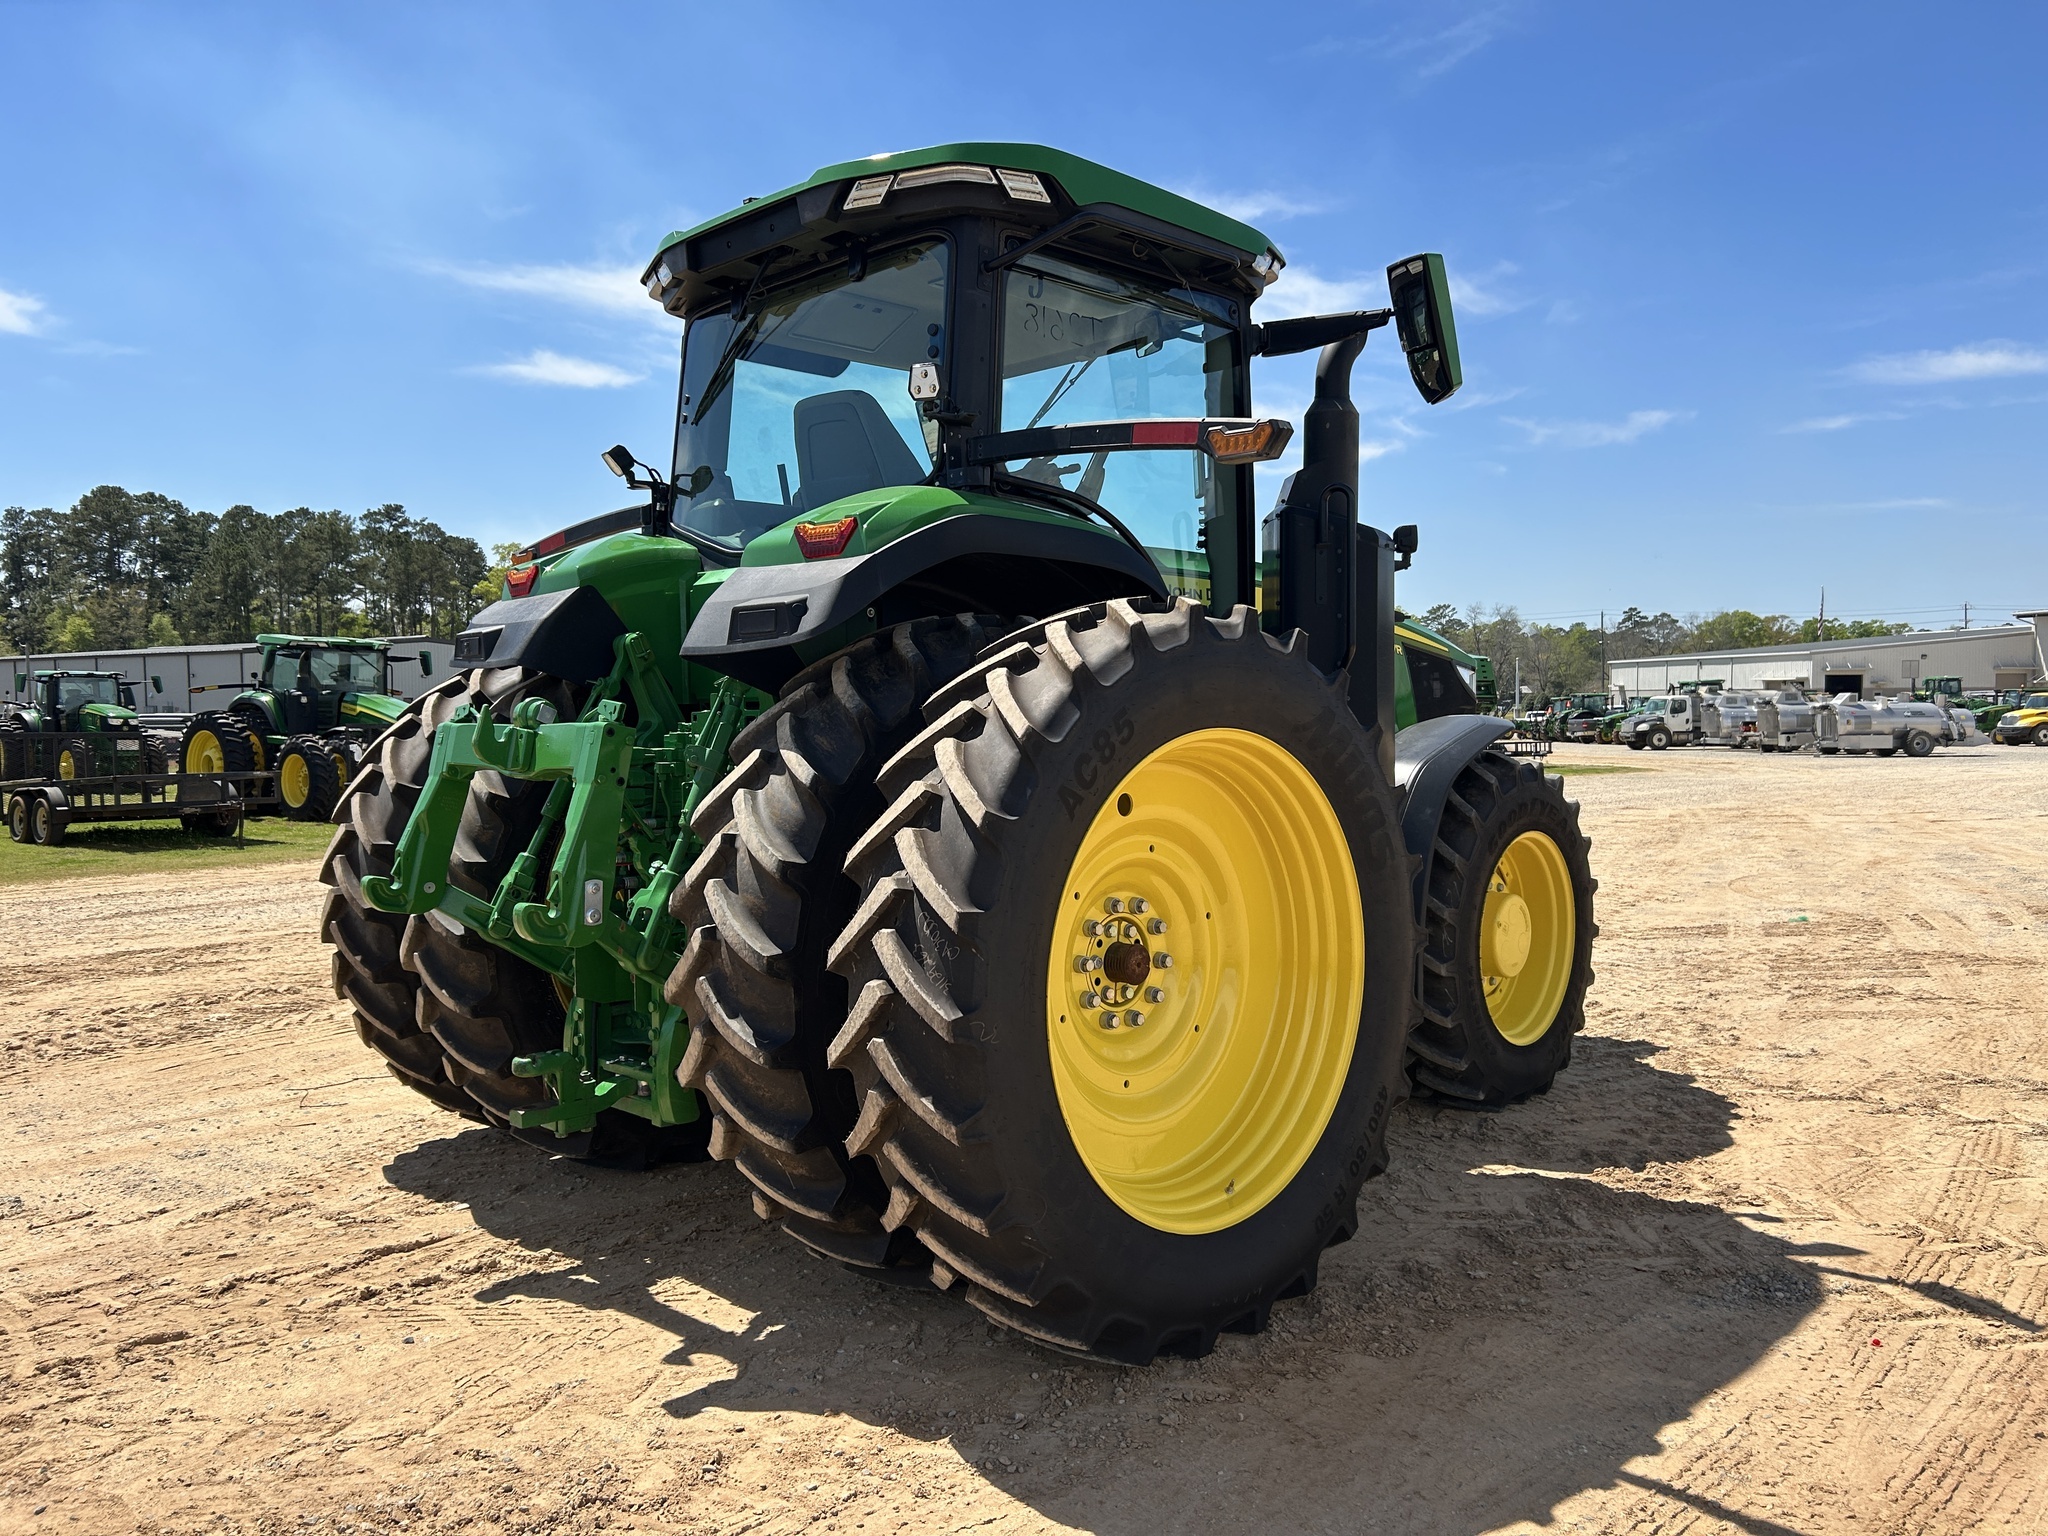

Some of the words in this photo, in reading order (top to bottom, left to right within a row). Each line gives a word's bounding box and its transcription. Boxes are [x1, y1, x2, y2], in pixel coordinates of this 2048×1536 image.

[1057, 705, 1135, 823] AC85
[1349, 1084, 1388, 1178] 480/80
[1314, 1203, 1335, 1234] 50
[1332, 1183, 1347, 1206] R
